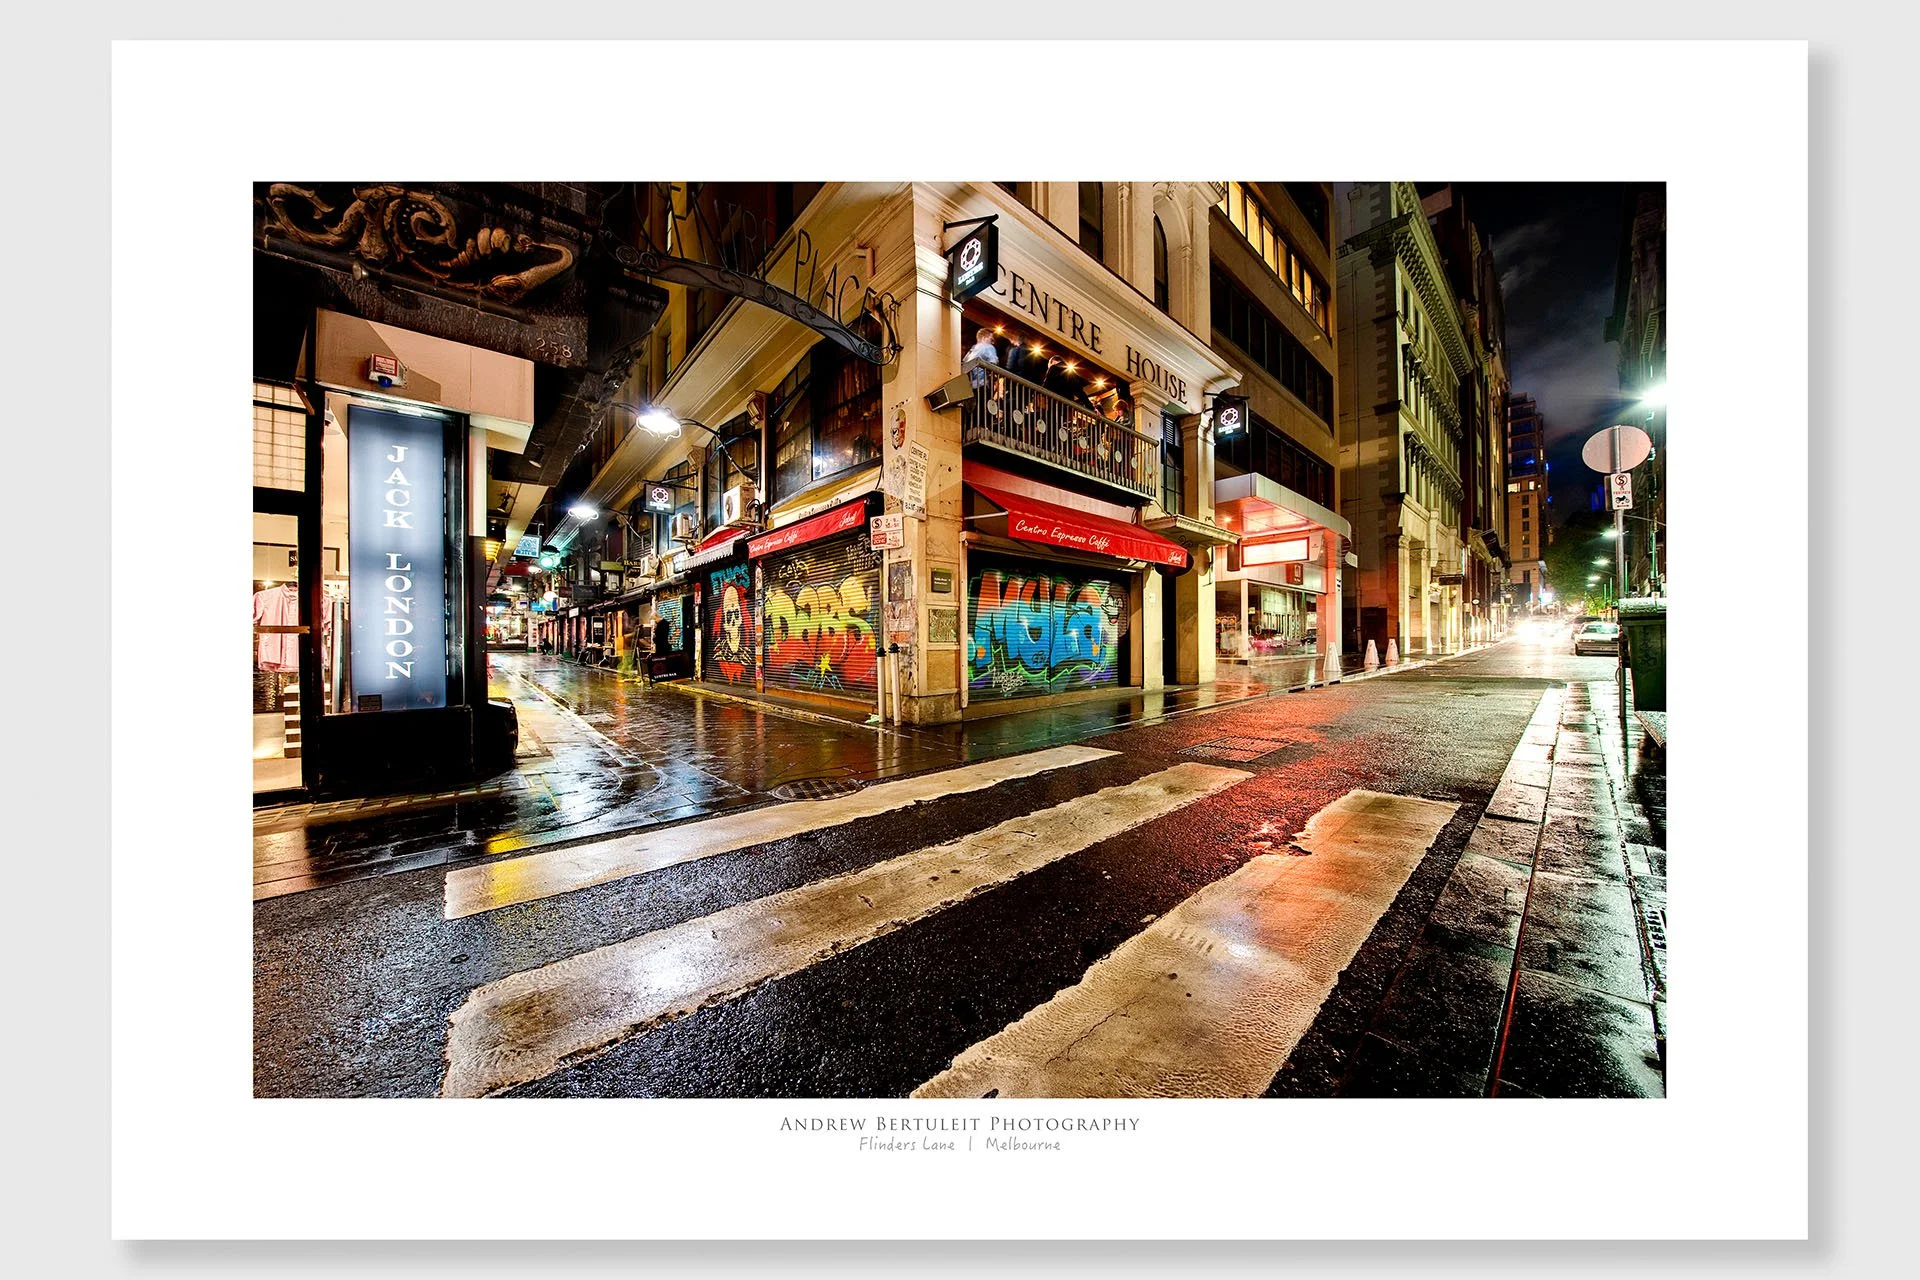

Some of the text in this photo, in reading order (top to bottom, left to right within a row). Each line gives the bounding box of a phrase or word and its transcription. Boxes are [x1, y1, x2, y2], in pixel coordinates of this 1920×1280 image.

[536, 337, 572, 358] 258
[988, 261, 1189, 405] CENTRE HOUSE
[384, 446, 412, 528] JACK
[1015, 519, 1047, 536] Centro
[1051, 526, 1087, 543] Espresso
[384, 554, 413, 678] LONDON
